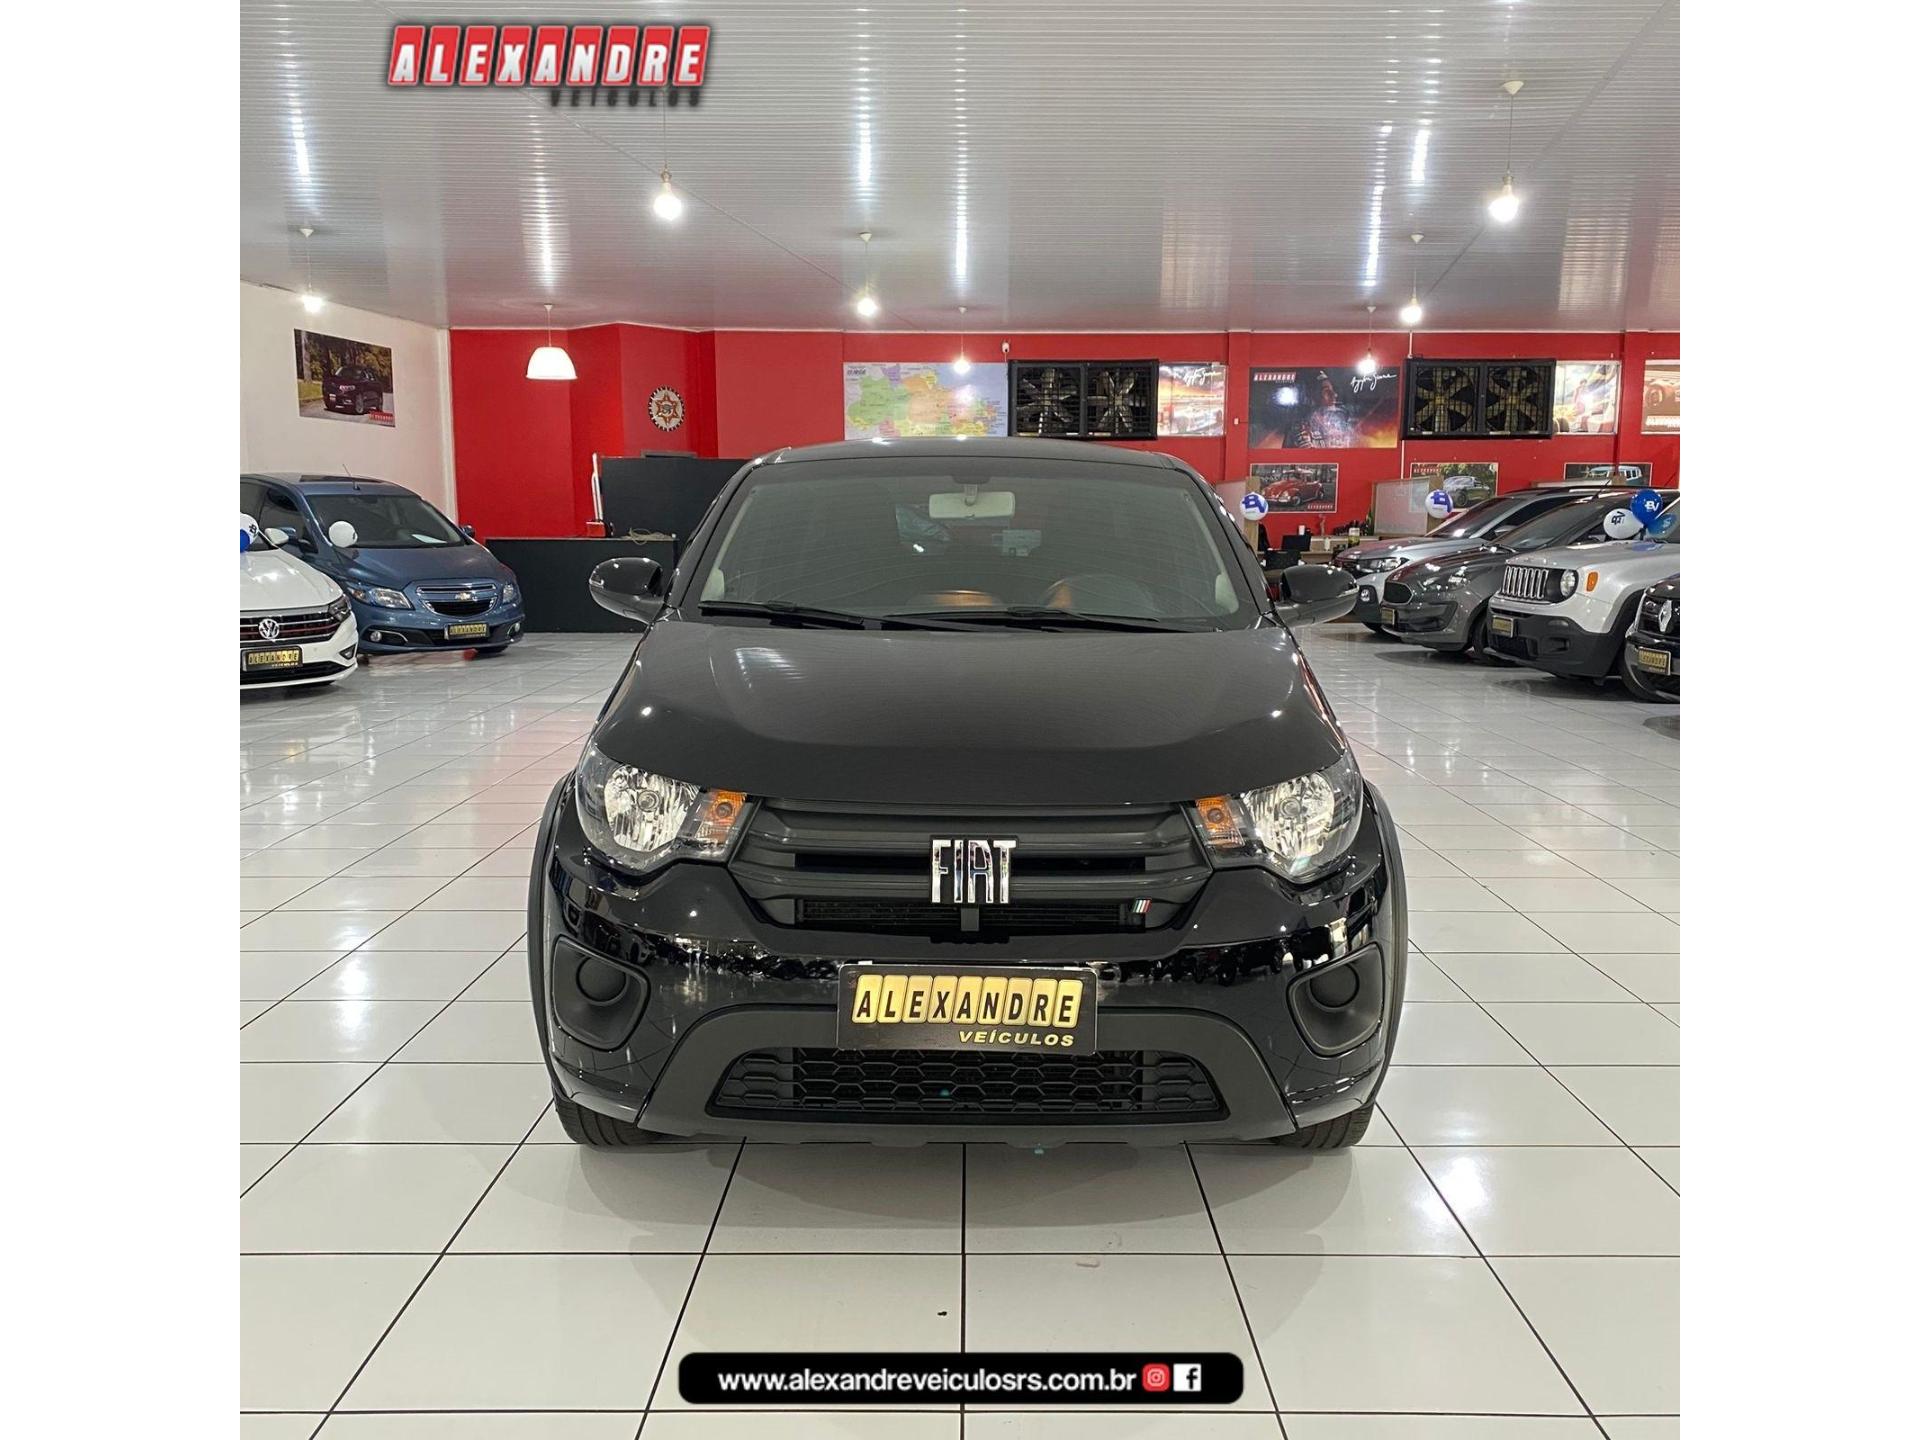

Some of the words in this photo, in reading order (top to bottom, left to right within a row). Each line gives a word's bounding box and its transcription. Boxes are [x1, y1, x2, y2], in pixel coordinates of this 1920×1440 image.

[931, 839, 1017, 904] FIAT
[855, 985, 1077, 1025] ALEXANDRE
[958, 1029, 1075, 1047] VEÍCULOS
